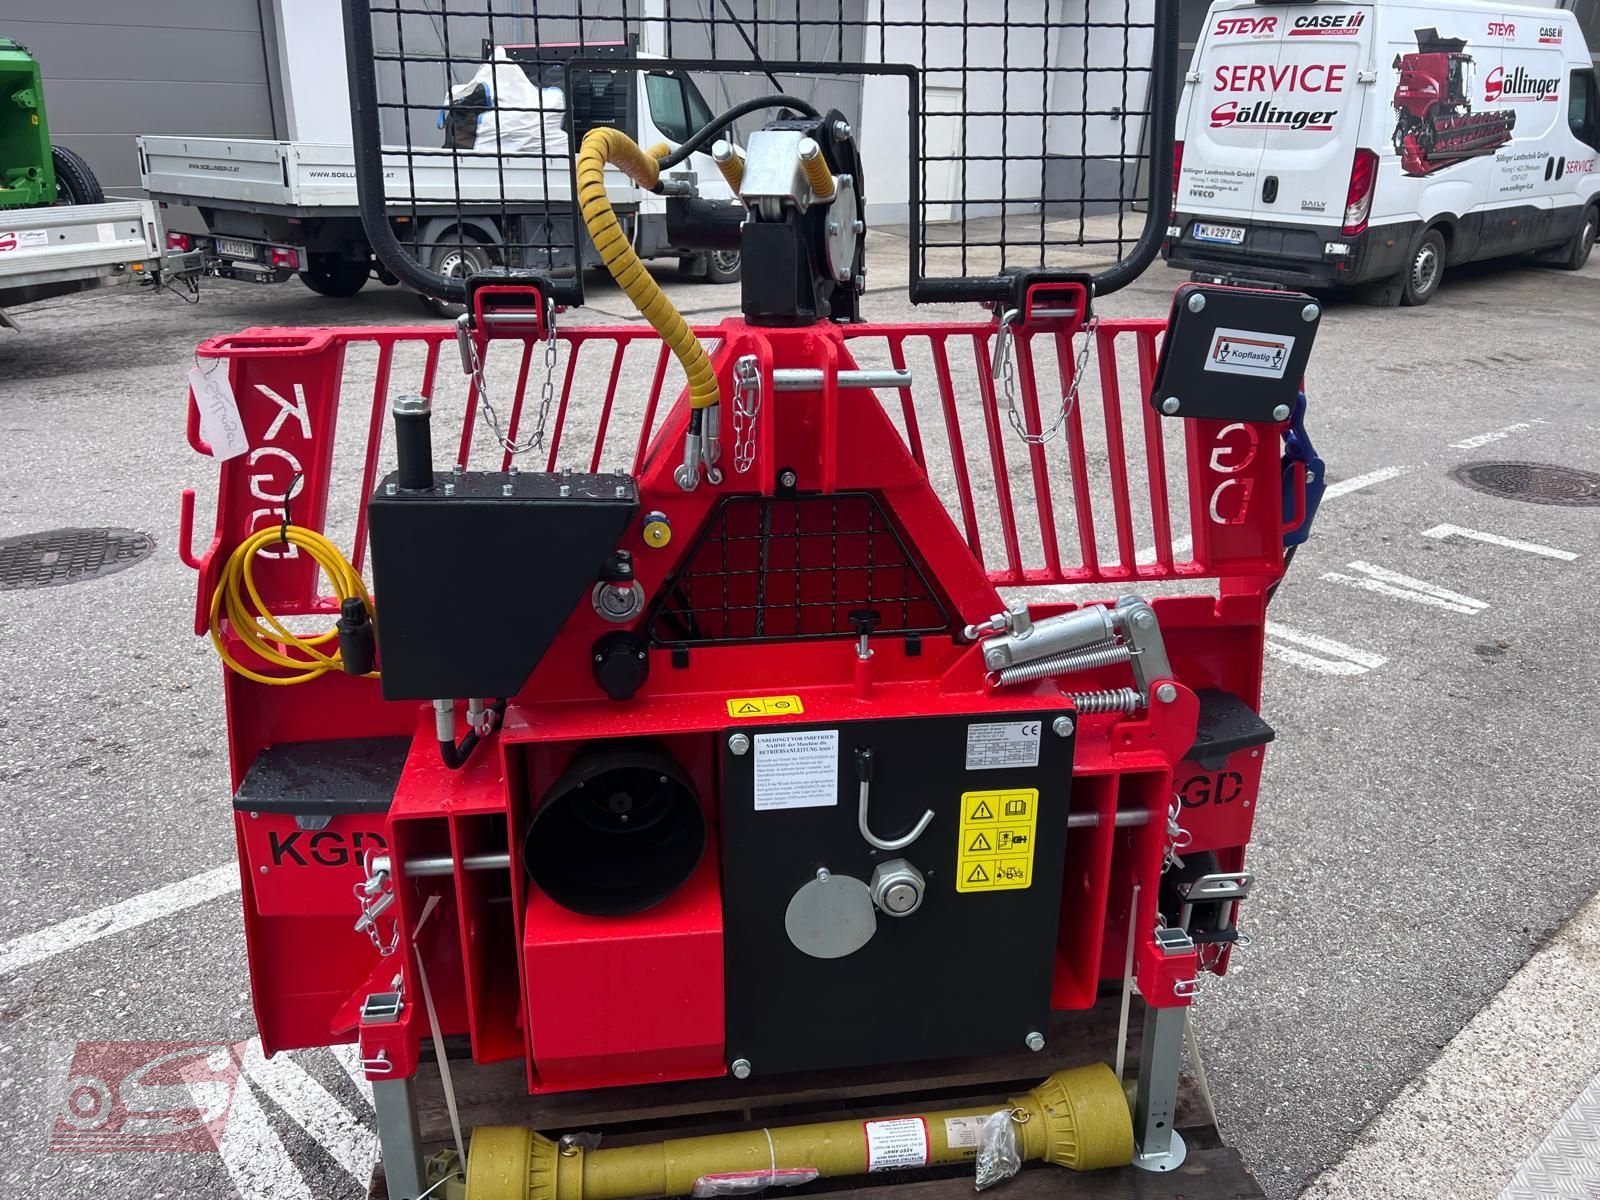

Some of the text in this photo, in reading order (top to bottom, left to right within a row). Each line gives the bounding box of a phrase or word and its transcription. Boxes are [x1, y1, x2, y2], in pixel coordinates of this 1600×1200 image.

[1214, 16, 1277, 35] STEYR
[1294, 15, 1346, 28] CASE
[1487, 22, 1515, 36] STEYR
[1539, 27, 1557, 37] CASE
[1213, 64, 1346, 92] SERVICE
[1484, 66, 1560, 102] Söllinger
[1209, 101, 1338, 129] Söllinger
[1565, 159, 1594, 174] SERVICE
[1190, 189, 1214, 198] IVECO
[1215, 227, 1231, 238] 297
[1231, 229, 1242, 240] DR
[1232, 349, 1270, 362] Kopflastig
[1021, 724, 1038, 736] CE
[1176, 771, 1242, 809] GD
[268, 831, 388, 866] KGD
